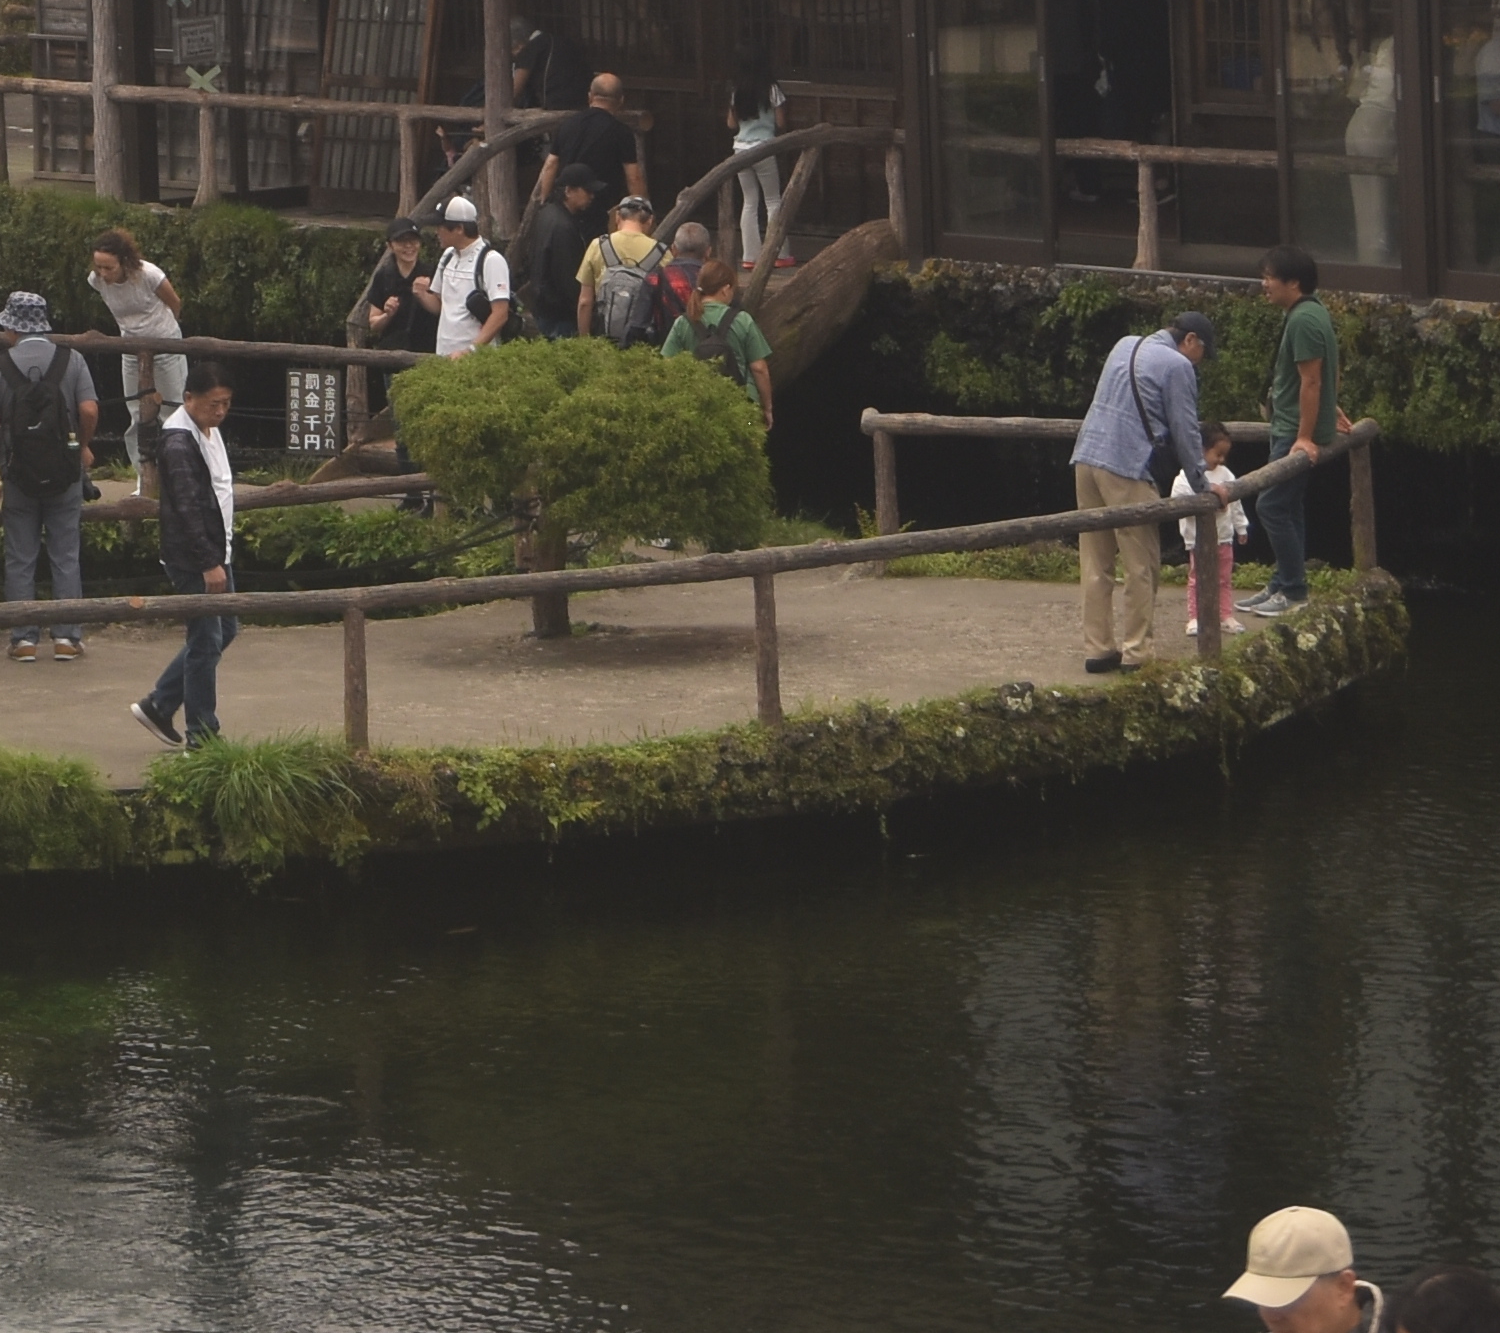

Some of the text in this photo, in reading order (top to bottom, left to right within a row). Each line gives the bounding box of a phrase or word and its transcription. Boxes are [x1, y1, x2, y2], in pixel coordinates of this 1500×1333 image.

[303, 373, 321, 450] 罰金千円
[324, 374, 336, 450] お金投げ入れ
